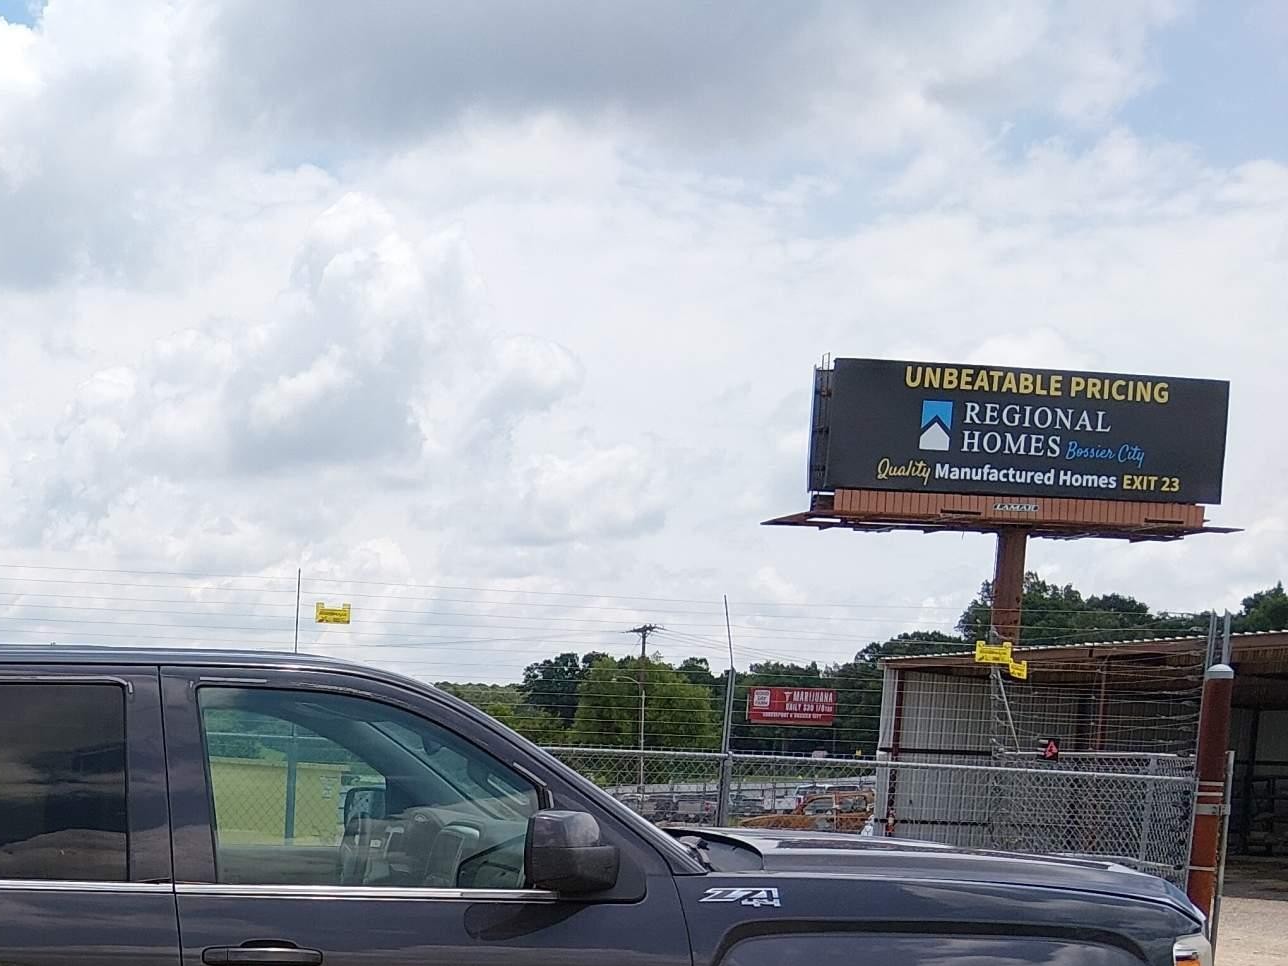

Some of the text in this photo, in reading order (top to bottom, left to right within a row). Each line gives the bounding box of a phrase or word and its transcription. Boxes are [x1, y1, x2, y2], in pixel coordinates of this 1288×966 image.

[905, 366, 1169, 403] UNBEATABLE PRICING
[964, 402, 1112, 433] REGIONAL
[961, 430, 1145, 469] HOMES Bossier City
[877, 458, 1180, 492] Quality Manufactured Homes EXIT 23
[792, 690, 833, 702] MARIJUANA
